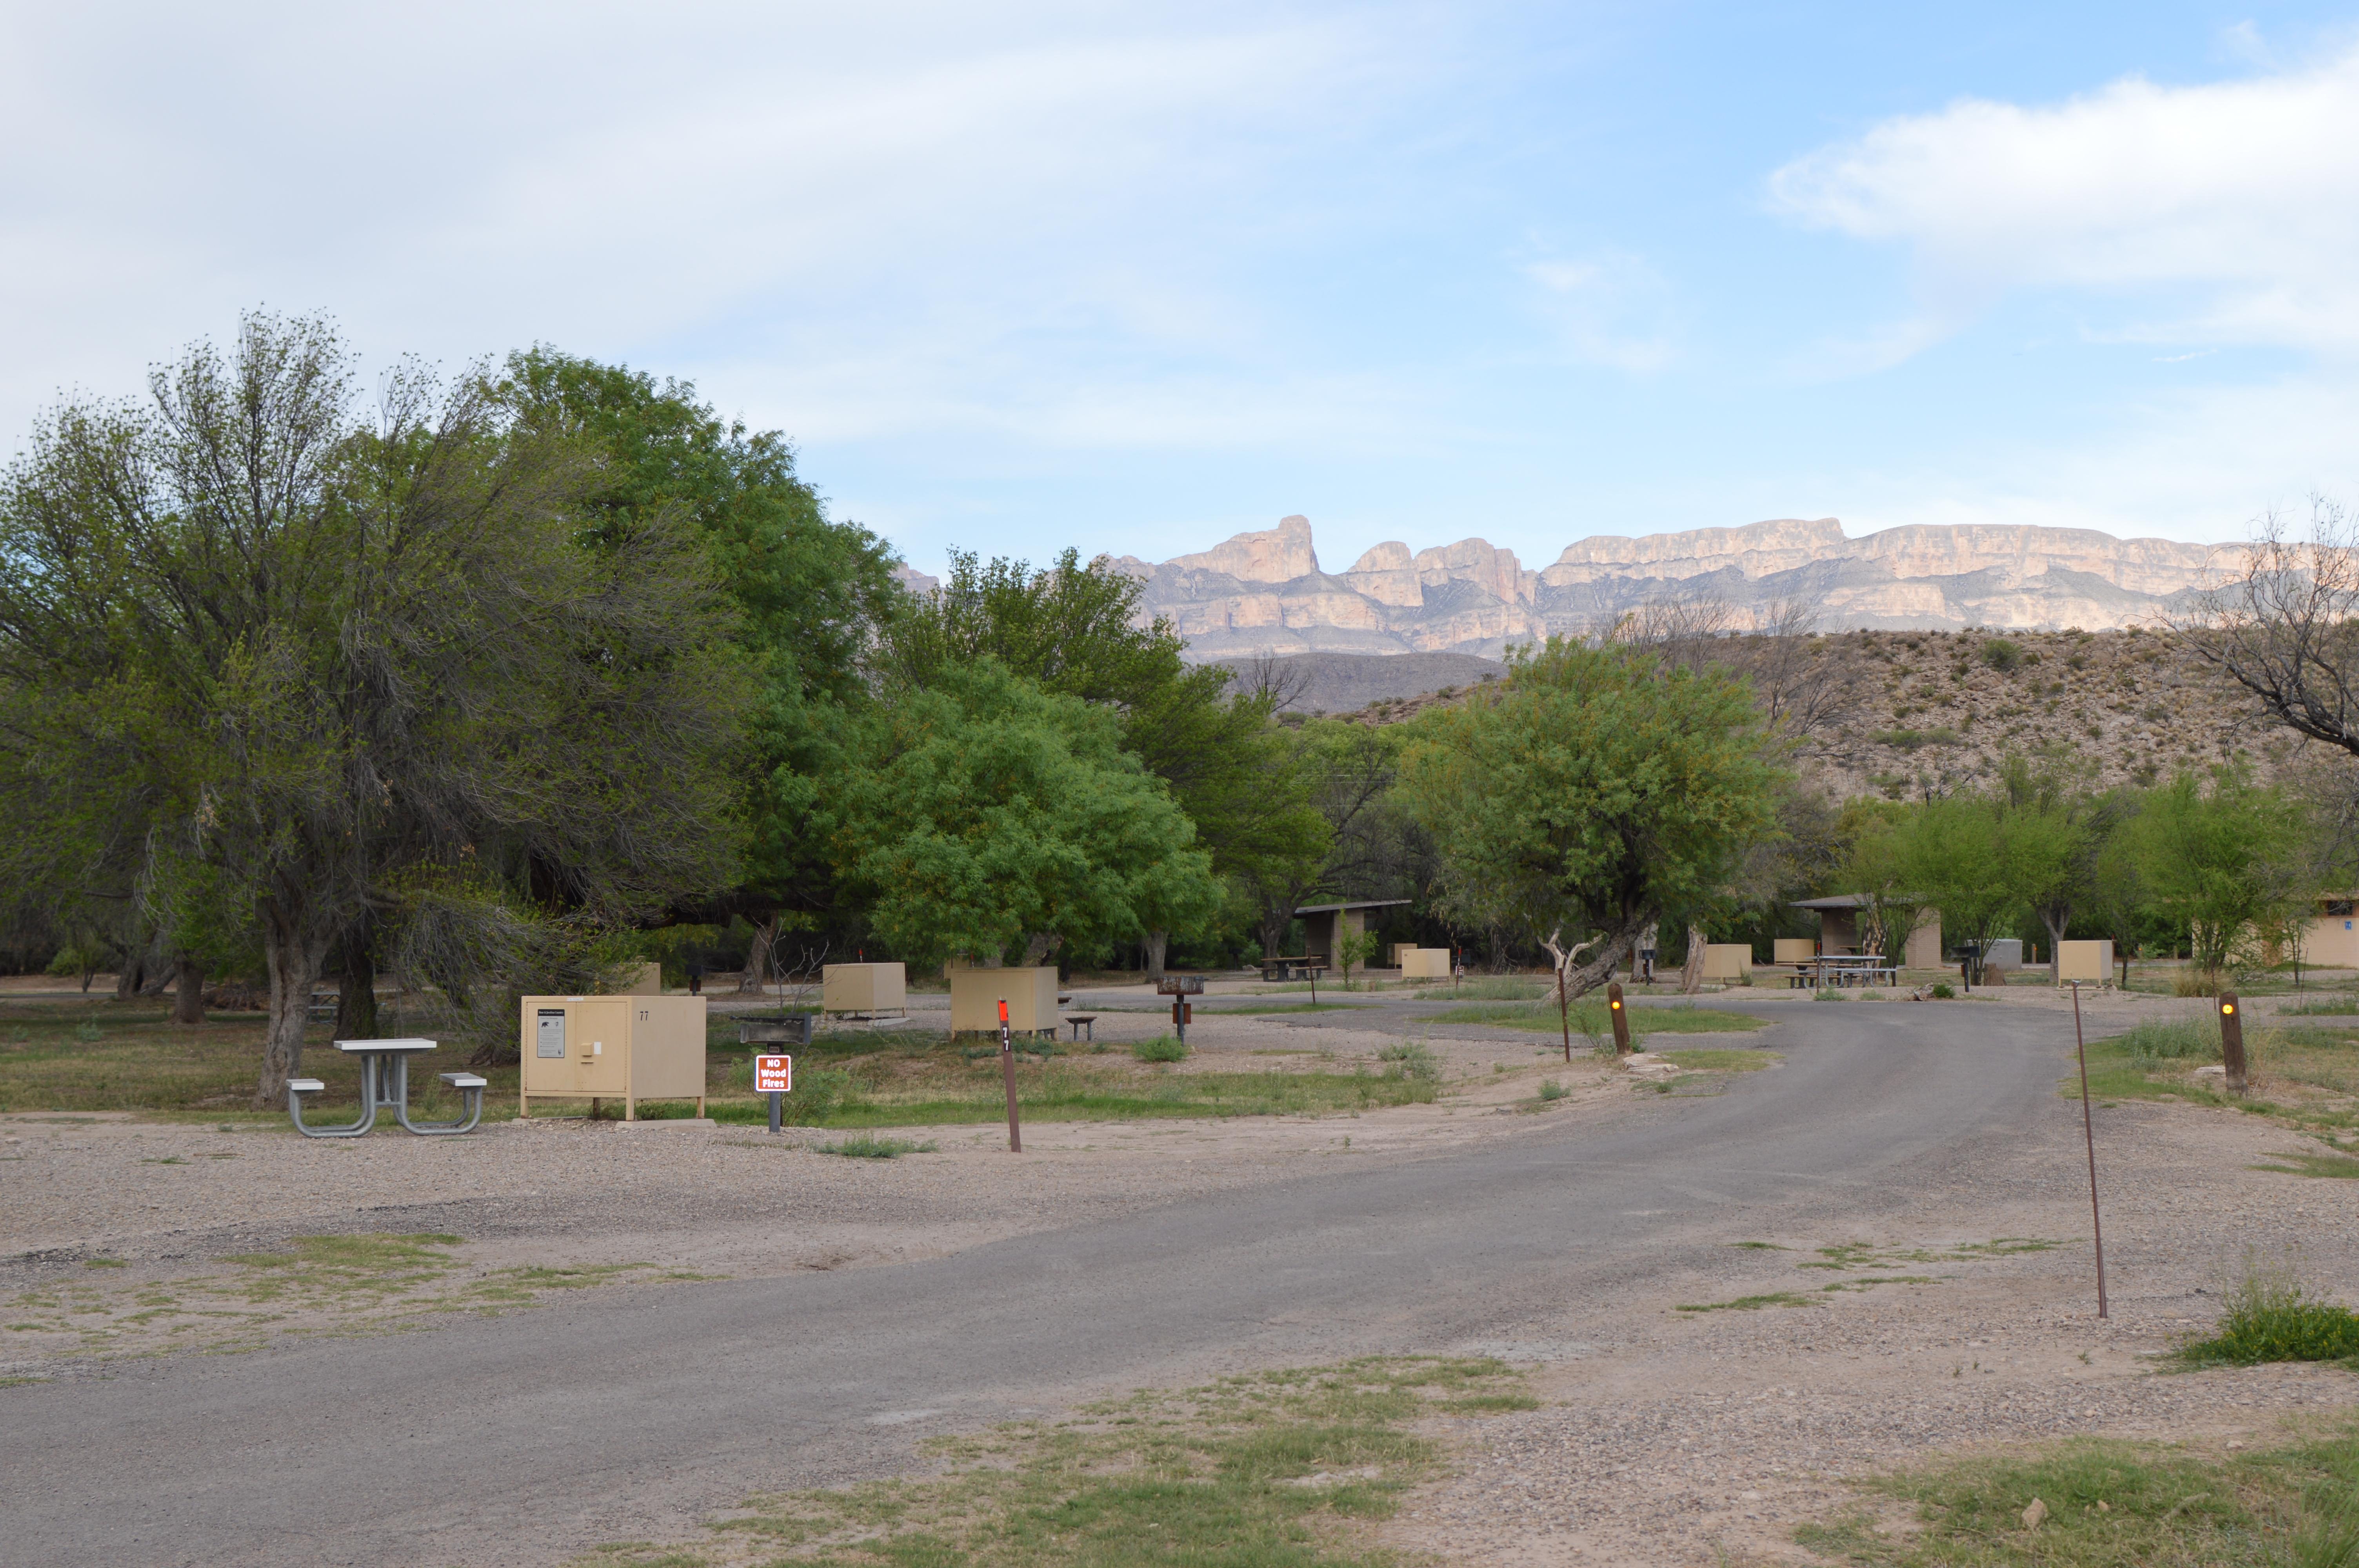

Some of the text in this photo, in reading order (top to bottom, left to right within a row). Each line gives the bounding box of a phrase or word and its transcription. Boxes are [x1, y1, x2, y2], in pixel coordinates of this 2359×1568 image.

[640, 1011, 649, 1021] 77
[1003, 1027, 1009, 1051] 77
[761, 1069, 786, 1077] Wood
[763, 1079, 785, 1087] Fires
